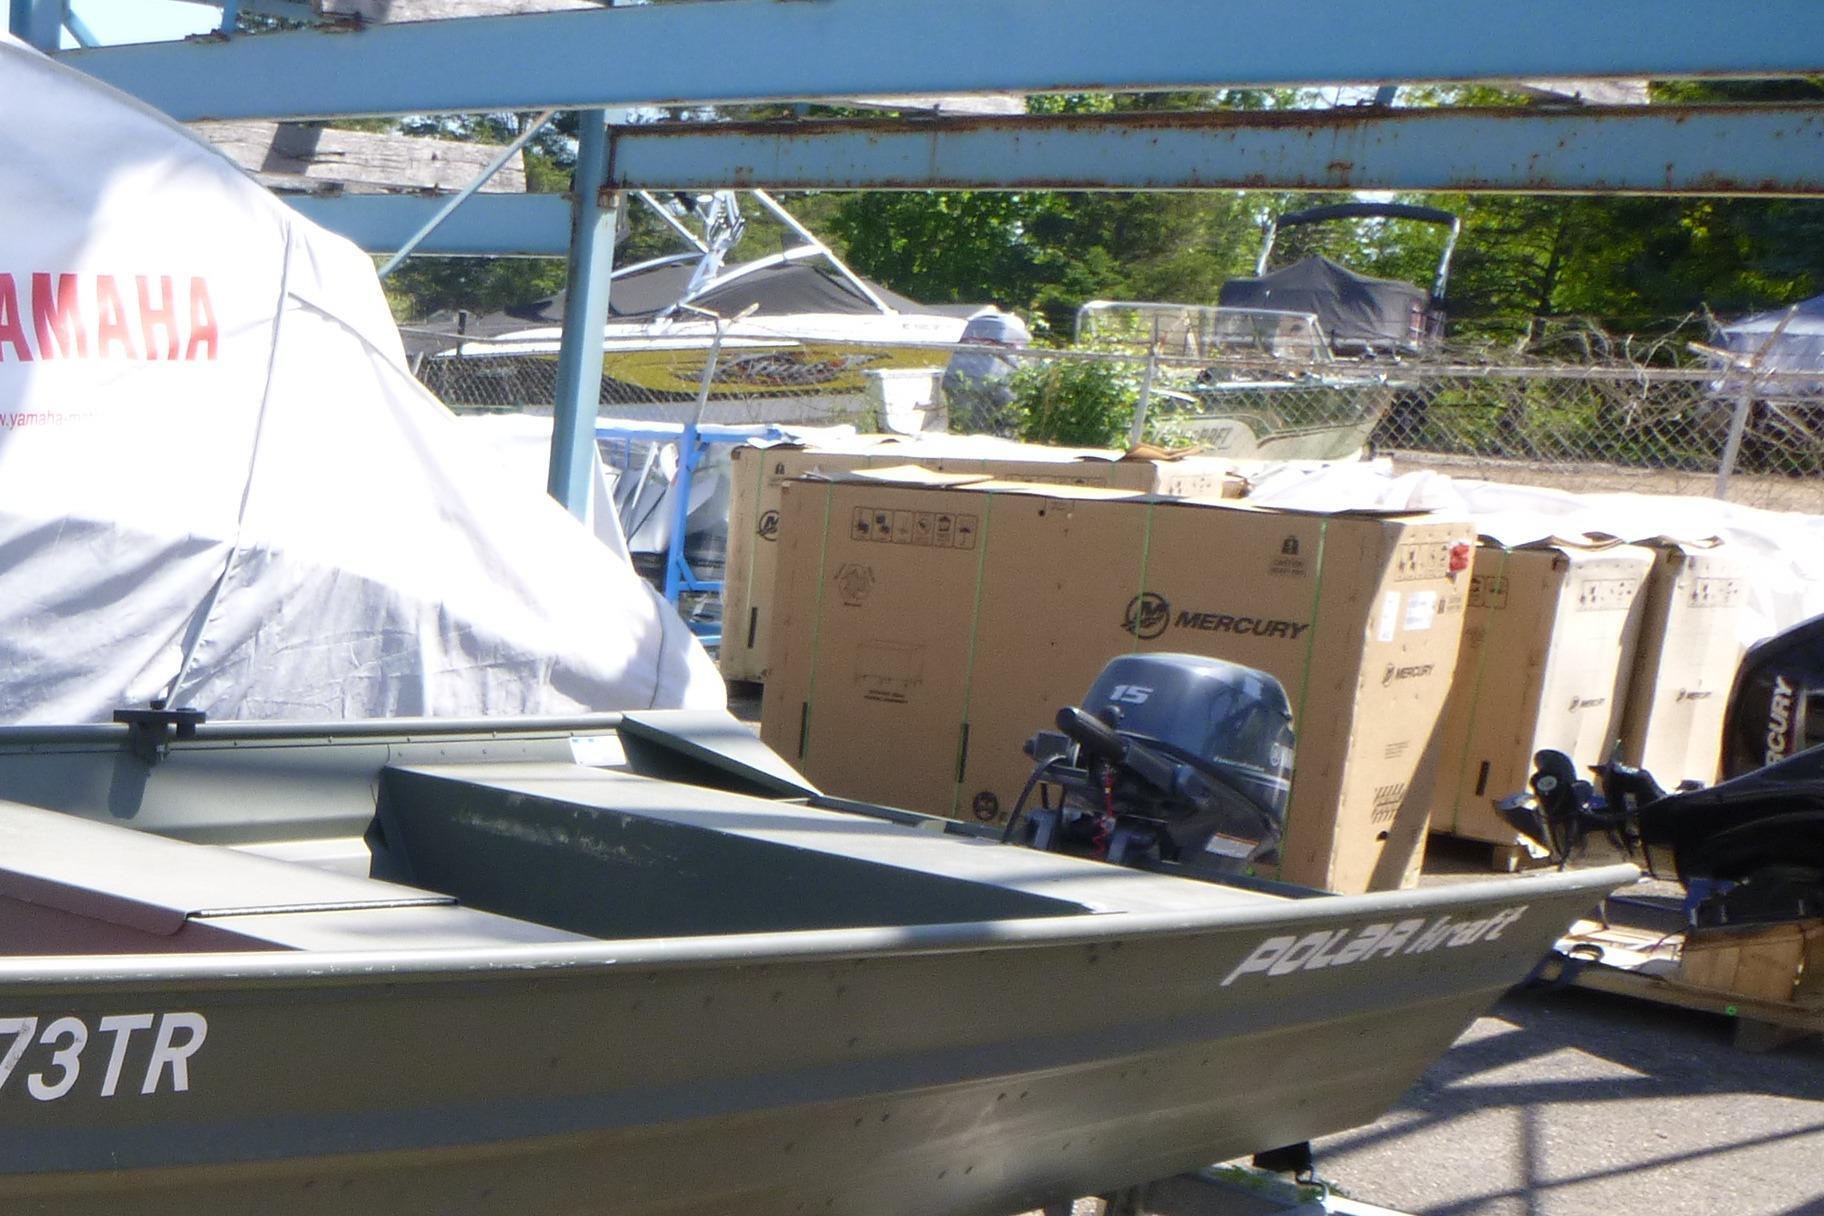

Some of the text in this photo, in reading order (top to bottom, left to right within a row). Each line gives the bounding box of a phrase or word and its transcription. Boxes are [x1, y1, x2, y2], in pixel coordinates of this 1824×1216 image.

[1174, 611, 1310, 639] MERCURY
[1395, 664, 1436, 679] MERCURY
[1108, 684, 1154, 705] 15
